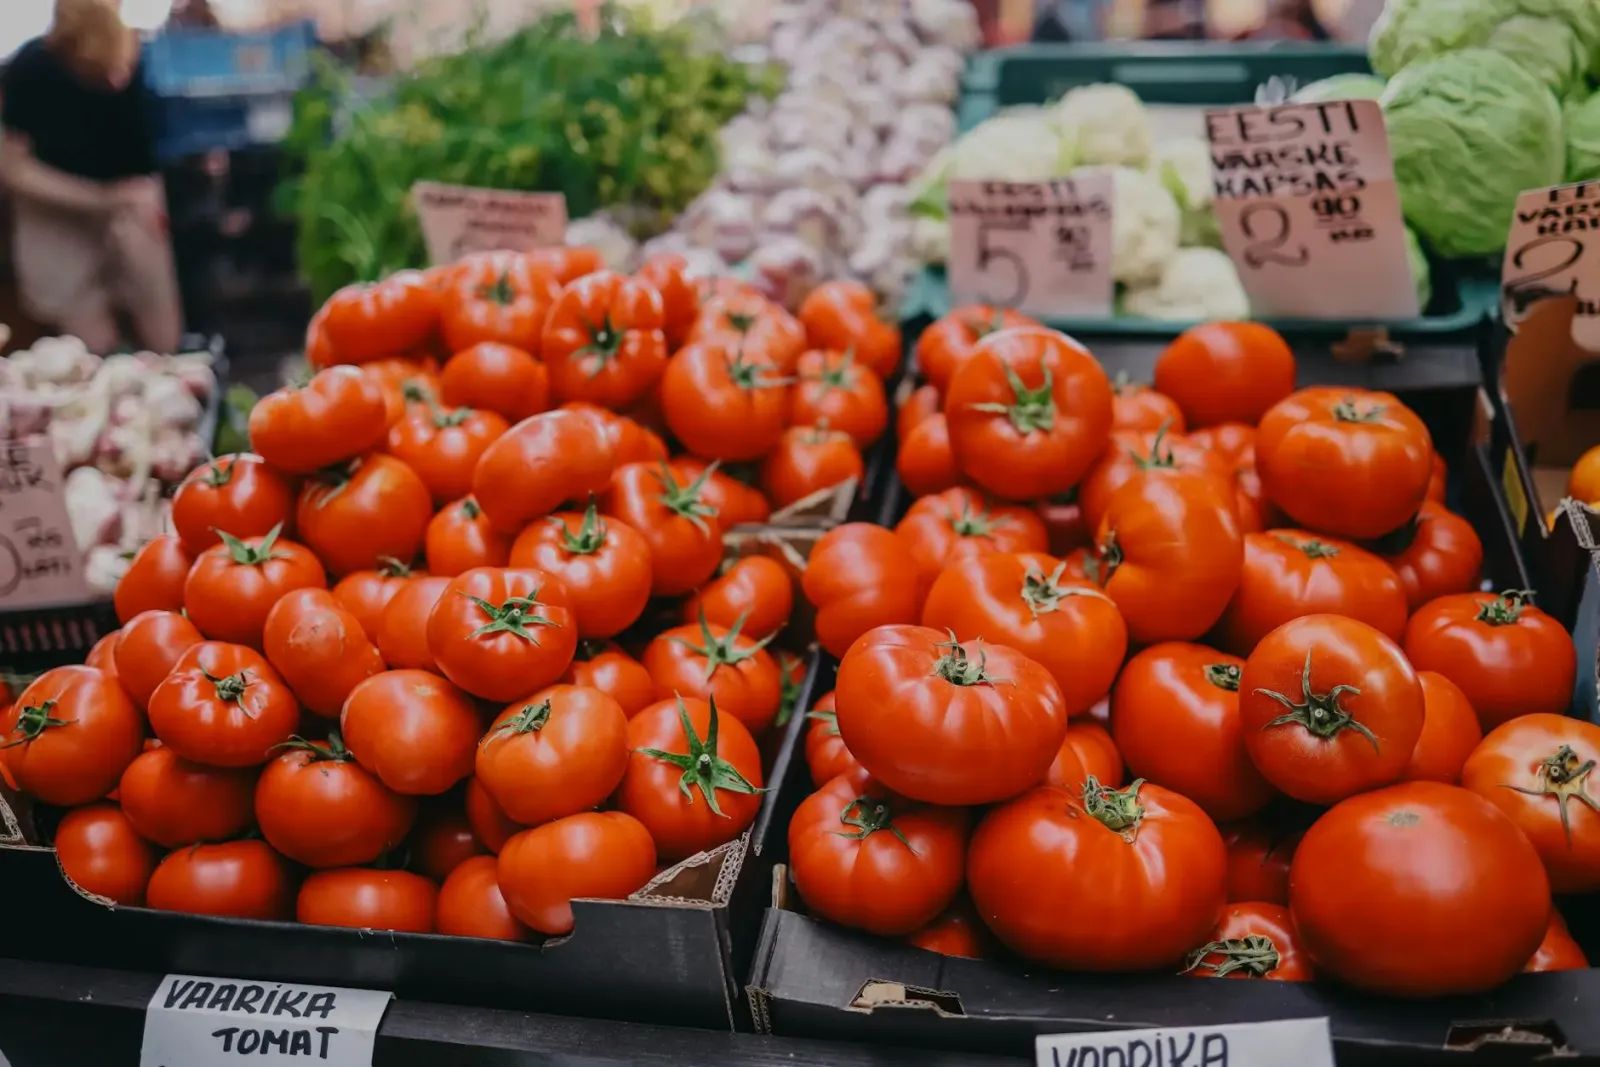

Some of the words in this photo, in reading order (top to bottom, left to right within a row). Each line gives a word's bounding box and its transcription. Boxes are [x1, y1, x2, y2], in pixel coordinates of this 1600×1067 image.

[1205, 101, 1359, 144] EESTI
[1214, 170, 1368, 198] KAPSAS
[1239, 202, 1309, 270] 2
[978, 220, 1030, 310] 5
[164, 979, 336, 1018] VAARIKA
[211, 1027, 339, 1059] TOMAT
